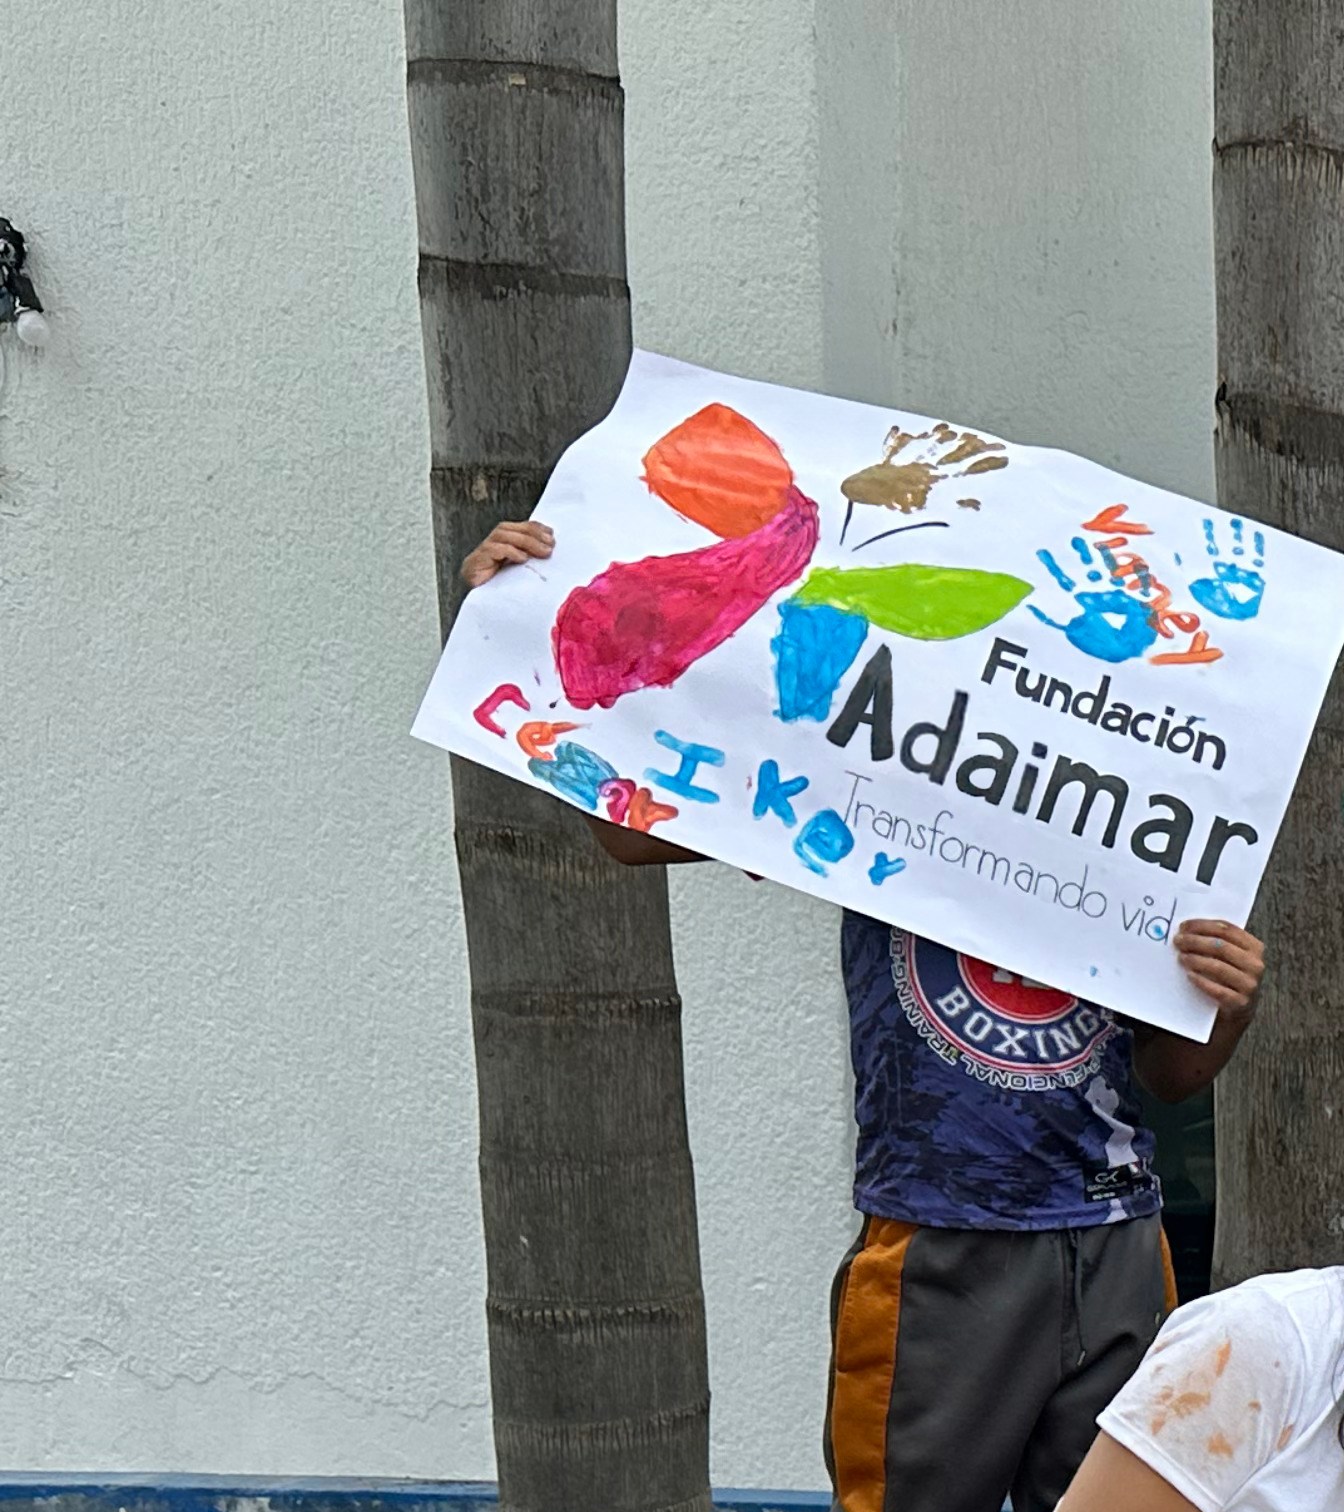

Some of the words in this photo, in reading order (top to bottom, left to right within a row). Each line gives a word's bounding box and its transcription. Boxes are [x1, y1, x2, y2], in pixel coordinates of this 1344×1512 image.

[826, 643, 1258, 885] Adaimar
[981, 637, 1227, 771] Fundación
[845, 771, 1108, 920] Transformando
[1122, 896, 1178, 945] vid
[890, 963, 960, 1066] TRAINING
[936, 985, 1101, 1060] BOXING
